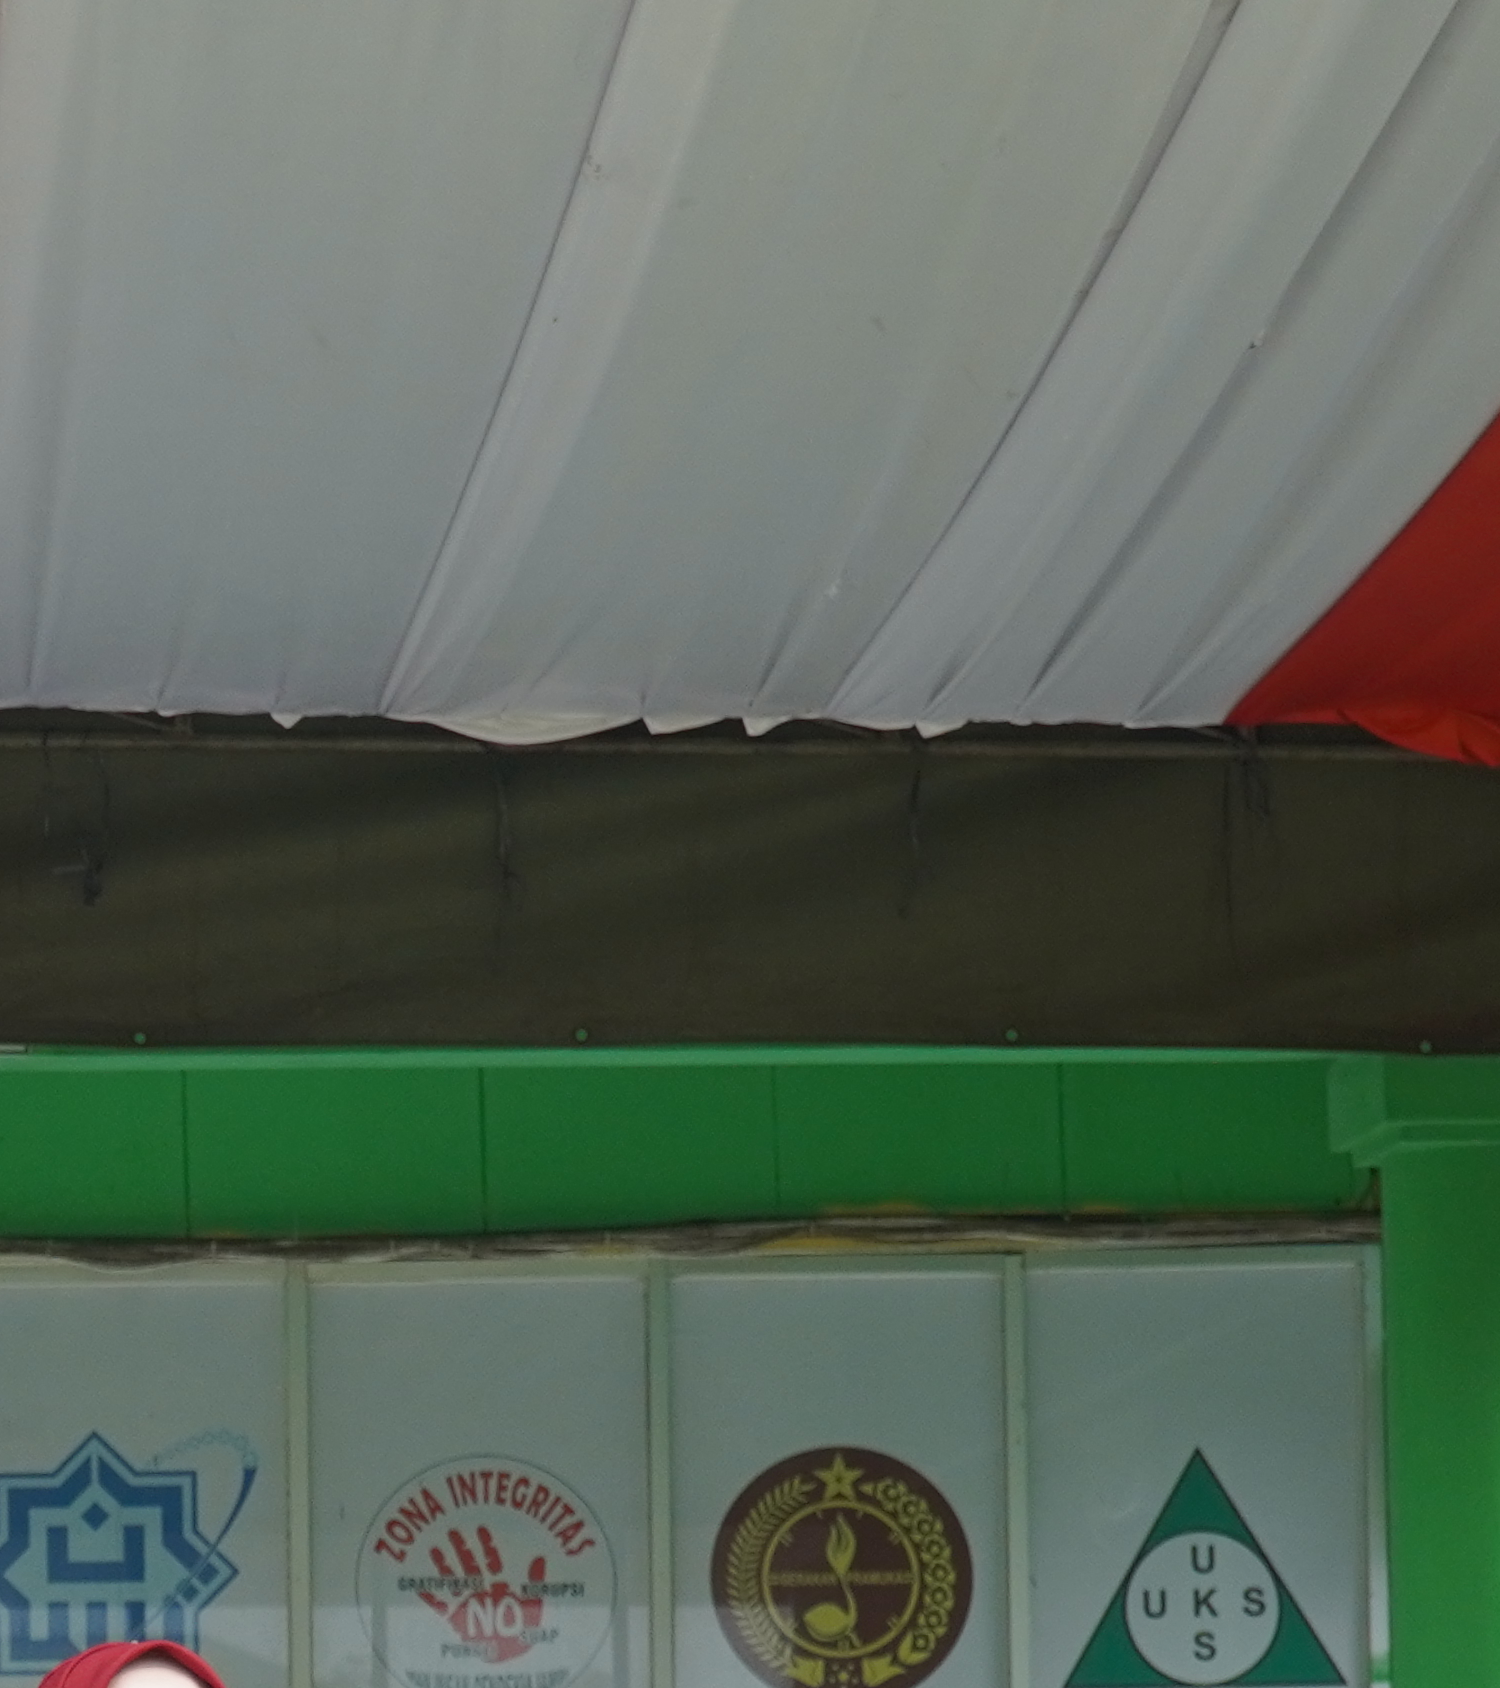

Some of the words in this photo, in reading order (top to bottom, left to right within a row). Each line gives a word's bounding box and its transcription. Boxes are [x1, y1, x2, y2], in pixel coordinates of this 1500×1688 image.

[374, 1486, 446, 1562] ZONA
[446, 1471, 596, 1557] INTEGRITAS
[465, 1597, 525, 1638] NO
